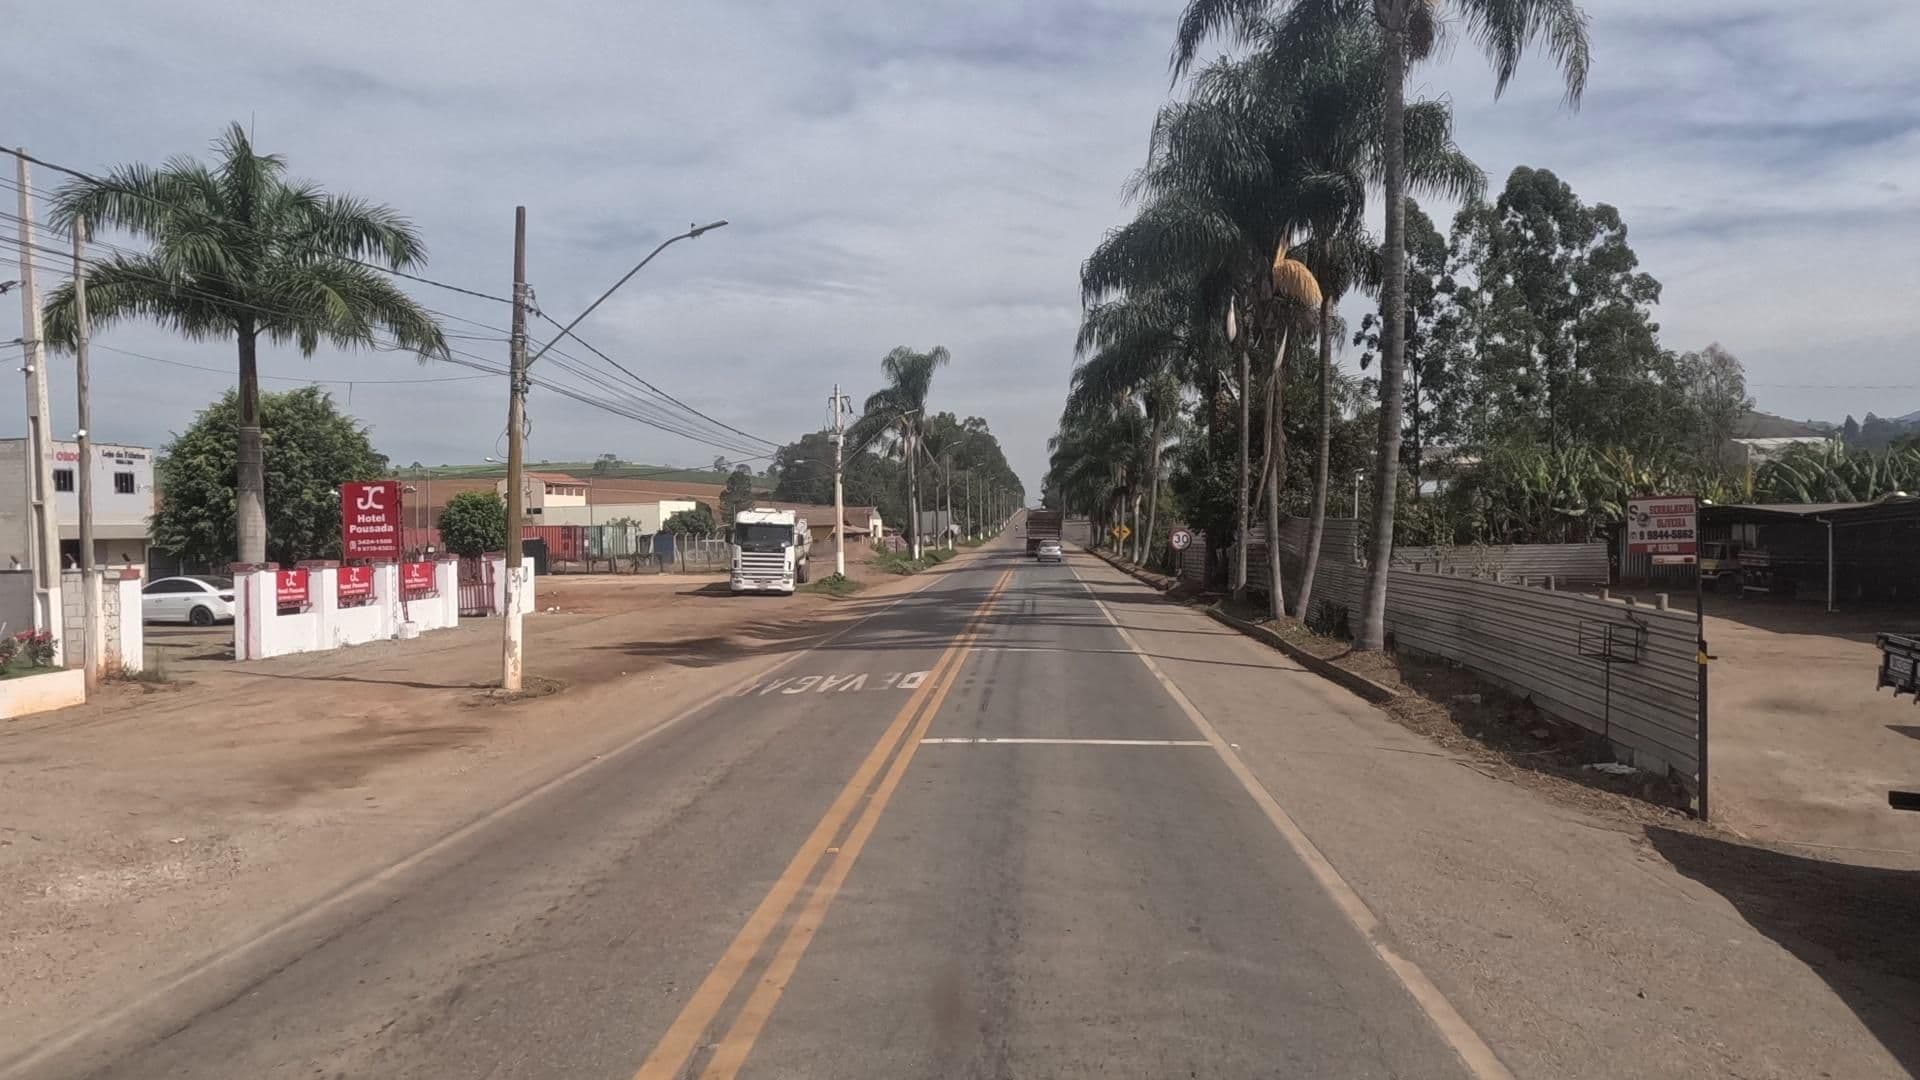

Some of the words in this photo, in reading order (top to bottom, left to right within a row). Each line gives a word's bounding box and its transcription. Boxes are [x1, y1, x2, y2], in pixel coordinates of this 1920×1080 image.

[357, 514, 386, 523] Hotel
[350, 524, 394, 533] Pousada
[1174, 534, 1189, 544] 30
